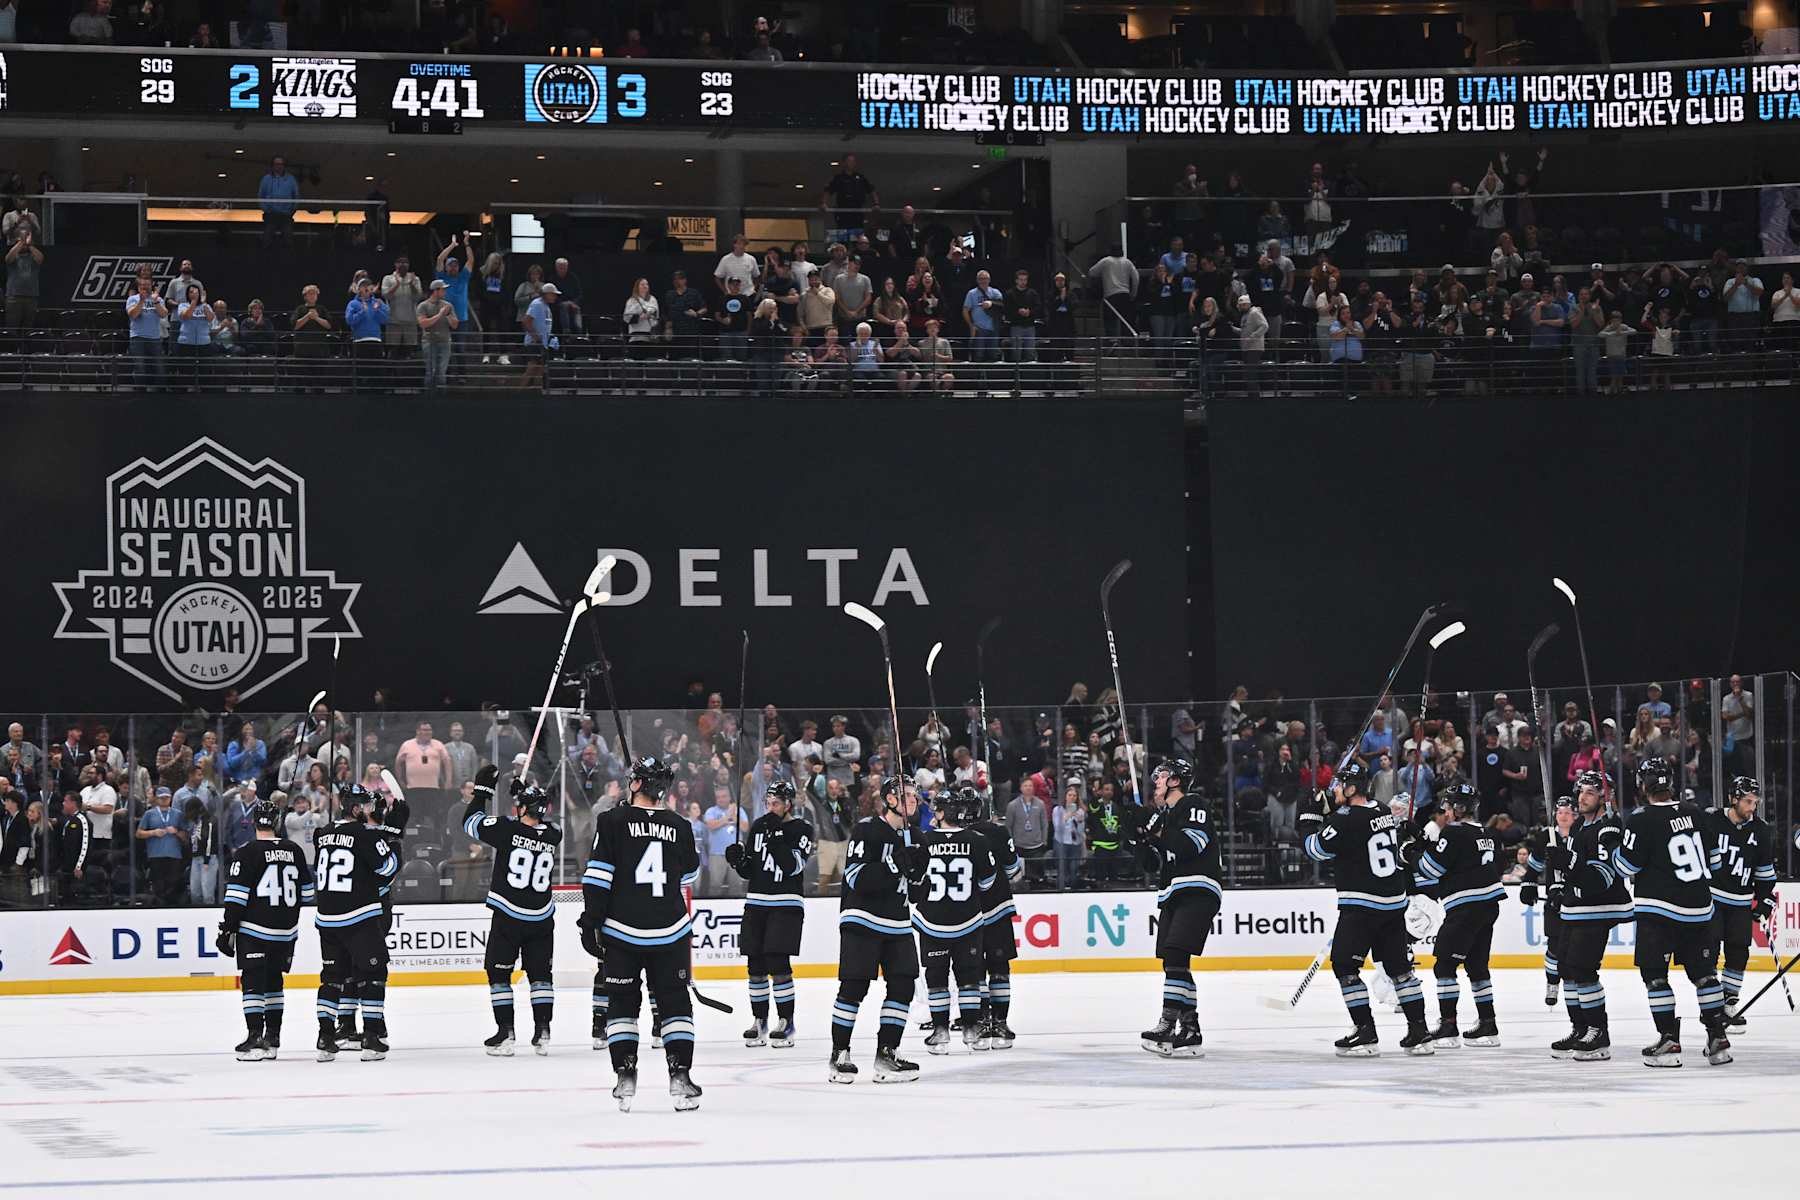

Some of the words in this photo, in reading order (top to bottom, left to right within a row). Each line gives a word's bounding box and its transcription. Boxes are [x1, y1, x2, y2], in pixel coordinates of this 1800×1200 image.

[140, 58, 173, 73] SOG
[410, 63, 471, 76] OVERTIME
[548, 66, 586, 80] HOCKEY
[140, 79, 175, 103] 29
[230, 64, 260, 109] 2
[272, 68, 357, 98] KINGS
[701, 72, 733, 86] SOG
[858, 73, 940, 101] HOCKEY
[944, 76, 1000, 102] CLUB
[1014, 77, 1071, 103] UTAH
[1076, 78, 1161, 105] HOCKEY
[1165, 79, 1222, 105] CLUB
[1235, 80, 1292, 105] UTAH
[1297, 78, 1382, 106] HOCKEY
[1387, 77, 1444, 106] CLUB
[1458, 76, 1517, 103] UTAH
[1522, 74, 1609, 102] HOCKEY
[1614, 71, 1672, 100] CLUB
[1687, 67, 1746, 96] UTAH
[1752, 64, 1800, 93] HOC
[392, 78, 484, 118] 4:41
[543, 82, 589, 105] UTAH
[617, 73, 646, 117] 3
[701, 92, 733, 116] 23
[553, 110, 579, 119] CLUB
[861, 102, 919, 128] UTAH
[924, 103, 1008, 131] HOCKEY
[1013, 105, 1069, 132] CLUB
[1082, 106, 1140, 132] UTAH
[1145, 106, 1230, 133] HOCKEY
[1234, 107, 1290, 134] CLUB
[1303, 107, 1361, 134] UTAH
[1366, 106, 1452, 134] HOCKEY
[1457, 104, 1515, 131] CLUB
[1528, 103, 1588, 129] UTAH
[1593, 98, 1681, 128] HOCKEY
[1685, 95, 1744, 126] CLUB
[453, 122, 460, 133] 2
[681, 218, 711, 233] STORE
[83, 262, 112, 297] 5
[119, 498, 292, 529] INAUGURAL
[120, 533, 293, 577] SEASON
[597, 548, 930, 607] DELTA
[93, 586, 154, 609] 2024
[263, 586, 322, 609] 2025
[179, 595, 239, 615] HOCKEY
[173, 620, 246, 655] UTAH
[190, 663, 230, 677] CLUB
[1189, 807, 1206, 824] 10
[1669, 815, 1694, 833] DOAN
[628, 821, 677, 843] VALIMAKI
[1622, 828, 1637, 850] 91
[264, 850, 295, 863] BARRON
[798, 835, 812, 854] 93
[847, 840, 865, 858] 84
[635, 841, 668, 897] 4
[1667, 831, 1713, 883] 91
[1718, 833, 1752, 887] UTAH
[316, 848, 355, 892] 82
[506, 847, 555, 893] 98
[928, 857, 974, 902] 63
[256, 864, 300, 907] 46
[1235, 911, 1325, 935] Health
[410, 958, 451, 966] LIMEADE
[1289, 960, 1321, 1007] WARRIOR
